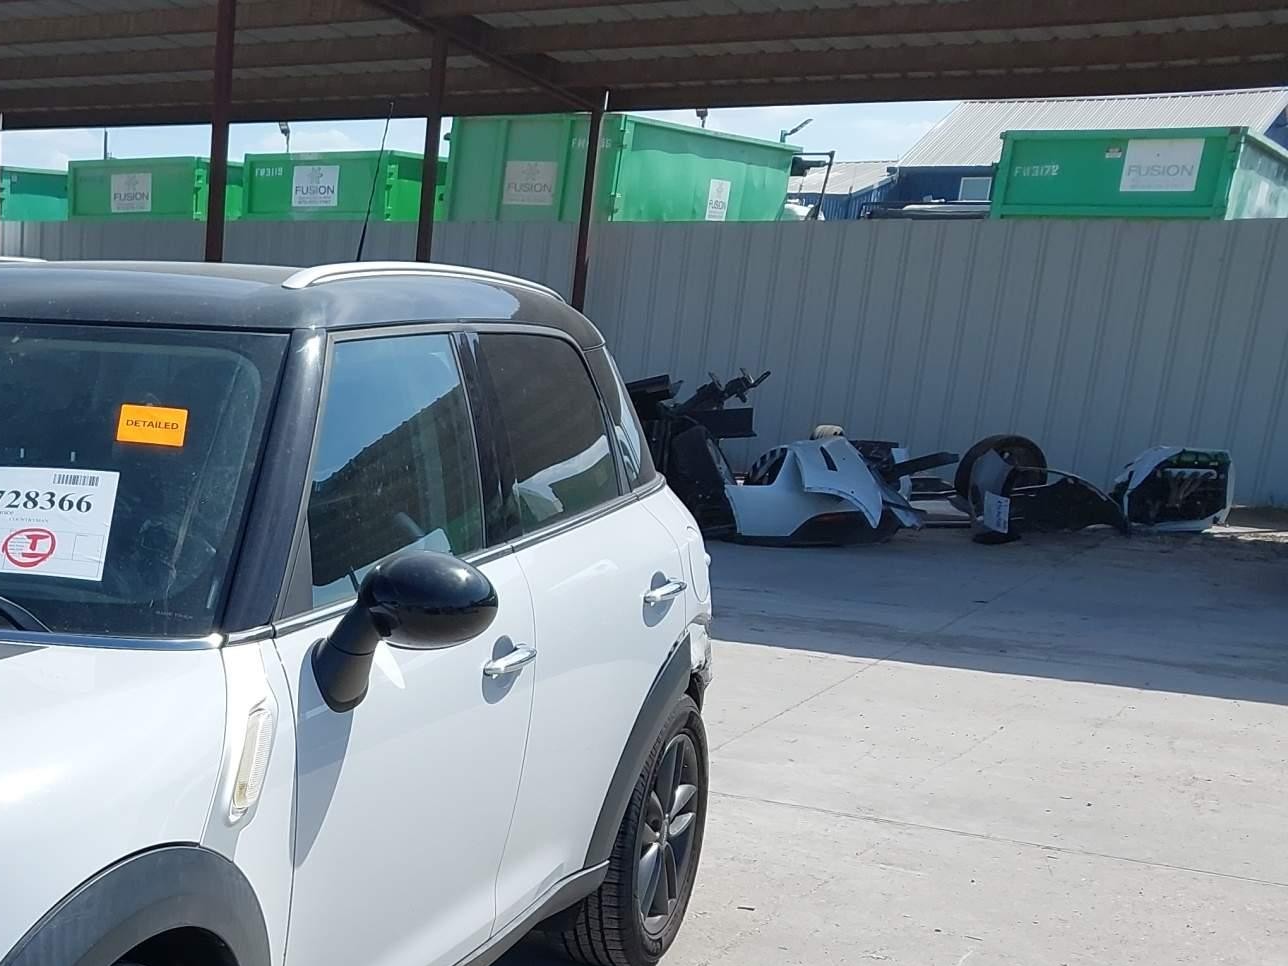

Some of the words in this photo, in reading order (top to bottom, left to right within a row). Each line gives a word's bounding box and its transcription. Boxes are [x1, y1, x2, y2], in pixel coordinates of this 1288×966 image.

[1127, 164, 1193, 177] FUSION
[295, 185, 335, 195] FUSION
[508, 183, 552, 193] FUSION
[114, 192, 150, 201] FUSION
[126, 420, 179, 430] DETAILED
